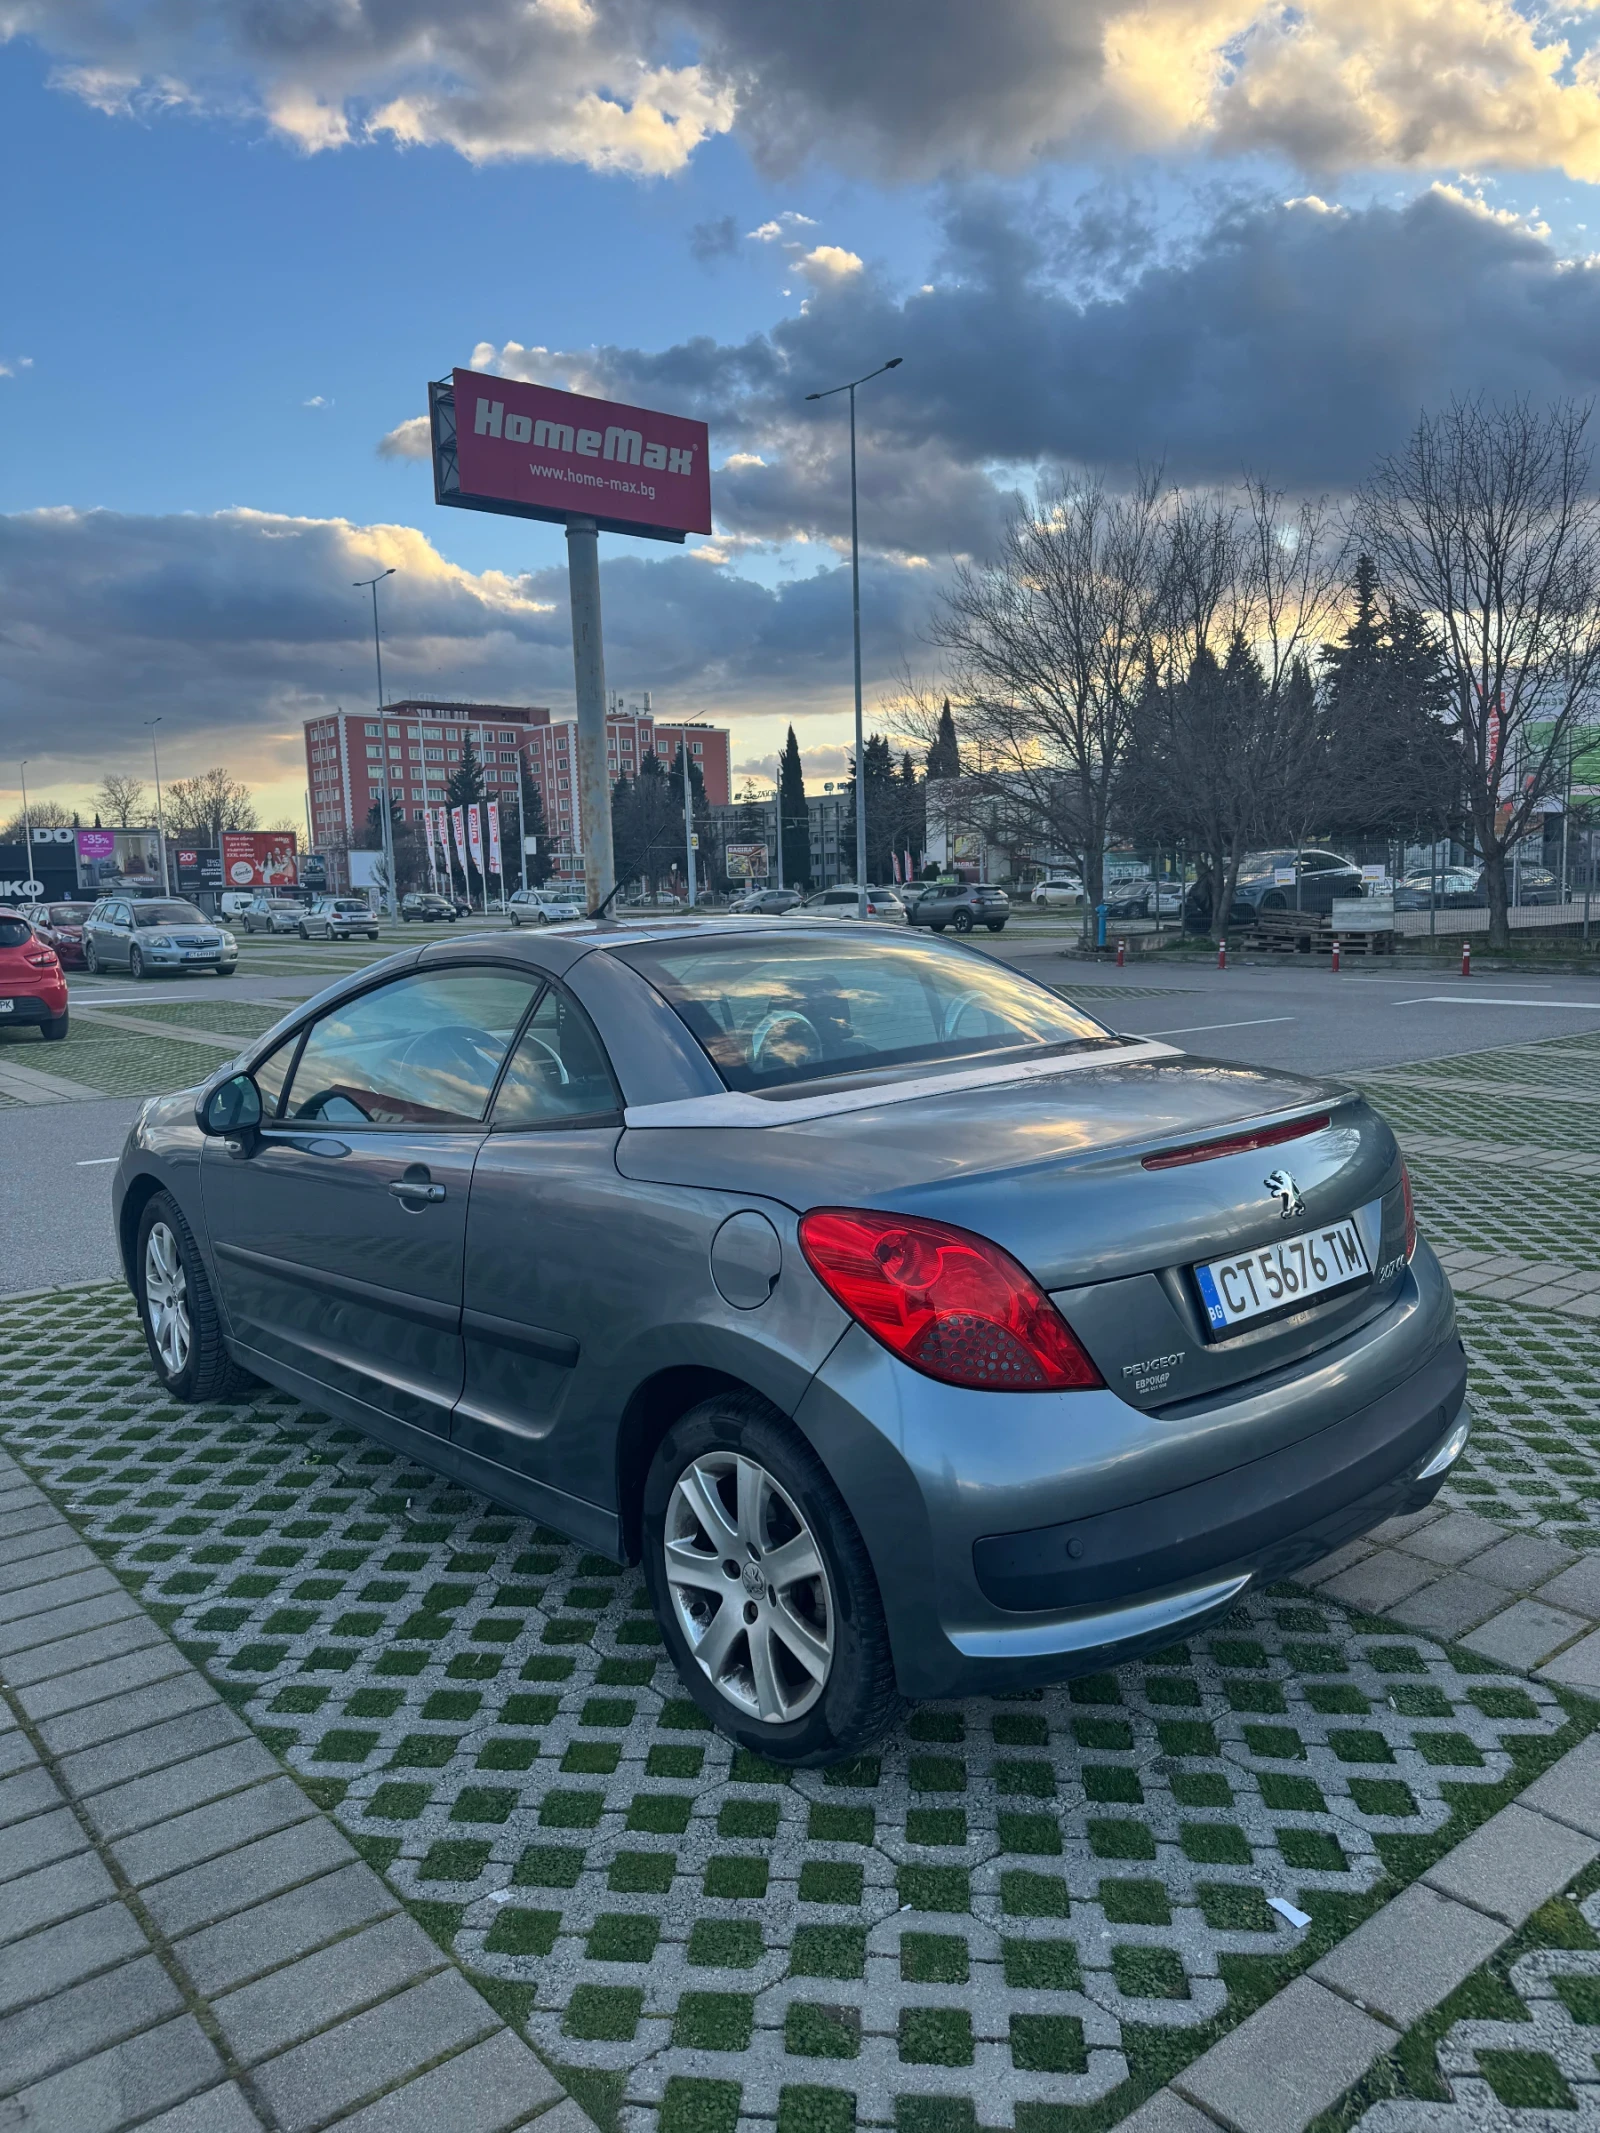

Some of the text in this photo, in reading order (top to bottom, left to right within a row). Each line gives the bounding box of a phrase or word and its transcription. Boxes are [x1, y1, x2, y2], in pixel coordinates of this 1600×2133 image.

[474, 397, 693, 476] HomeMax
[529, 463, 656, 500] www.home-max.bg
[33, 828, 74, 843] DO
[0, 1000, 12, 1009] PK
[1207, 1304, 1223, 1321] BG
[1121, 1352, 1185, 1378] PEUGEOT
[1135, 1372, 1170, 1390] ЕВРОКАР
